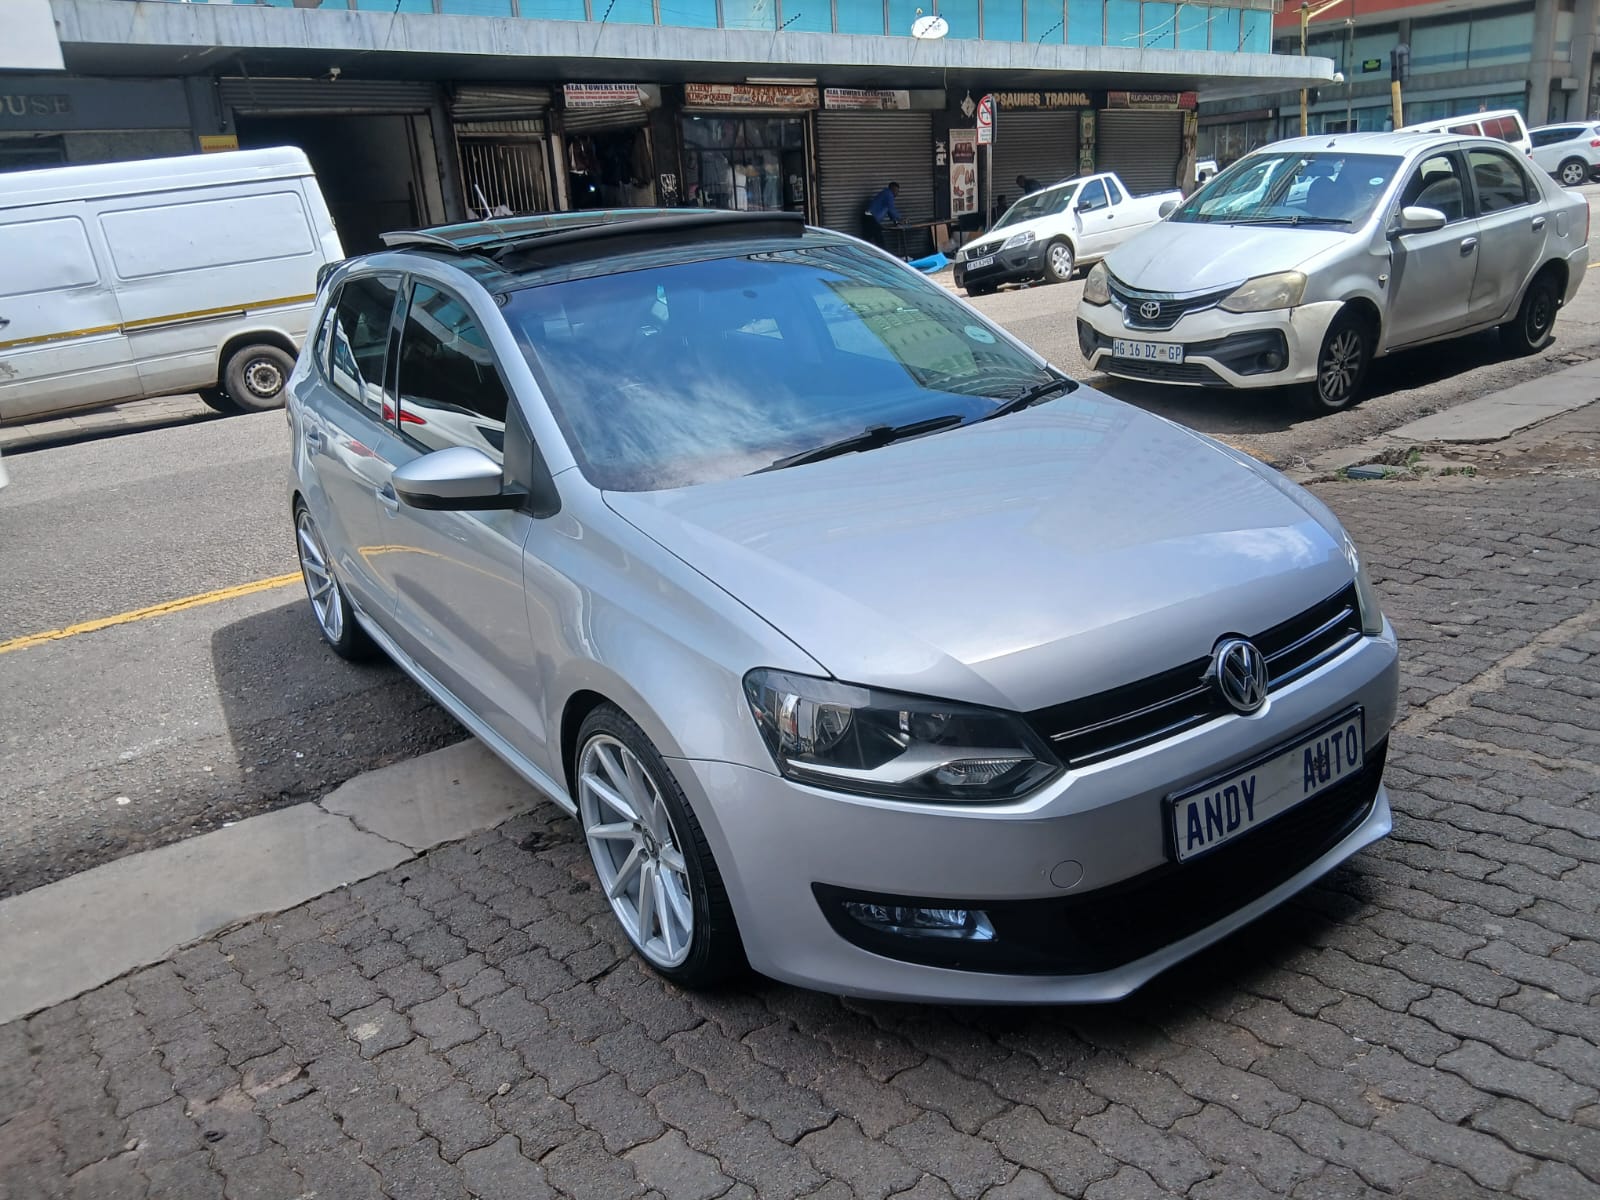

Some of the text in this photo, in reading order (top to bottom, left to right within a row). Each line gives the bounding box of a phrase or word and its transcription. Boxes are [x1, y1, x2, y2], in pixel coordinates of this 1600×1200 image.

[994, 92, 1086, 107] PSAUMES TRADING
[1114, 340, 1181, 360] HG 16 DZ GP
[1186, 724, 1359, 850] ANDY AUTO
